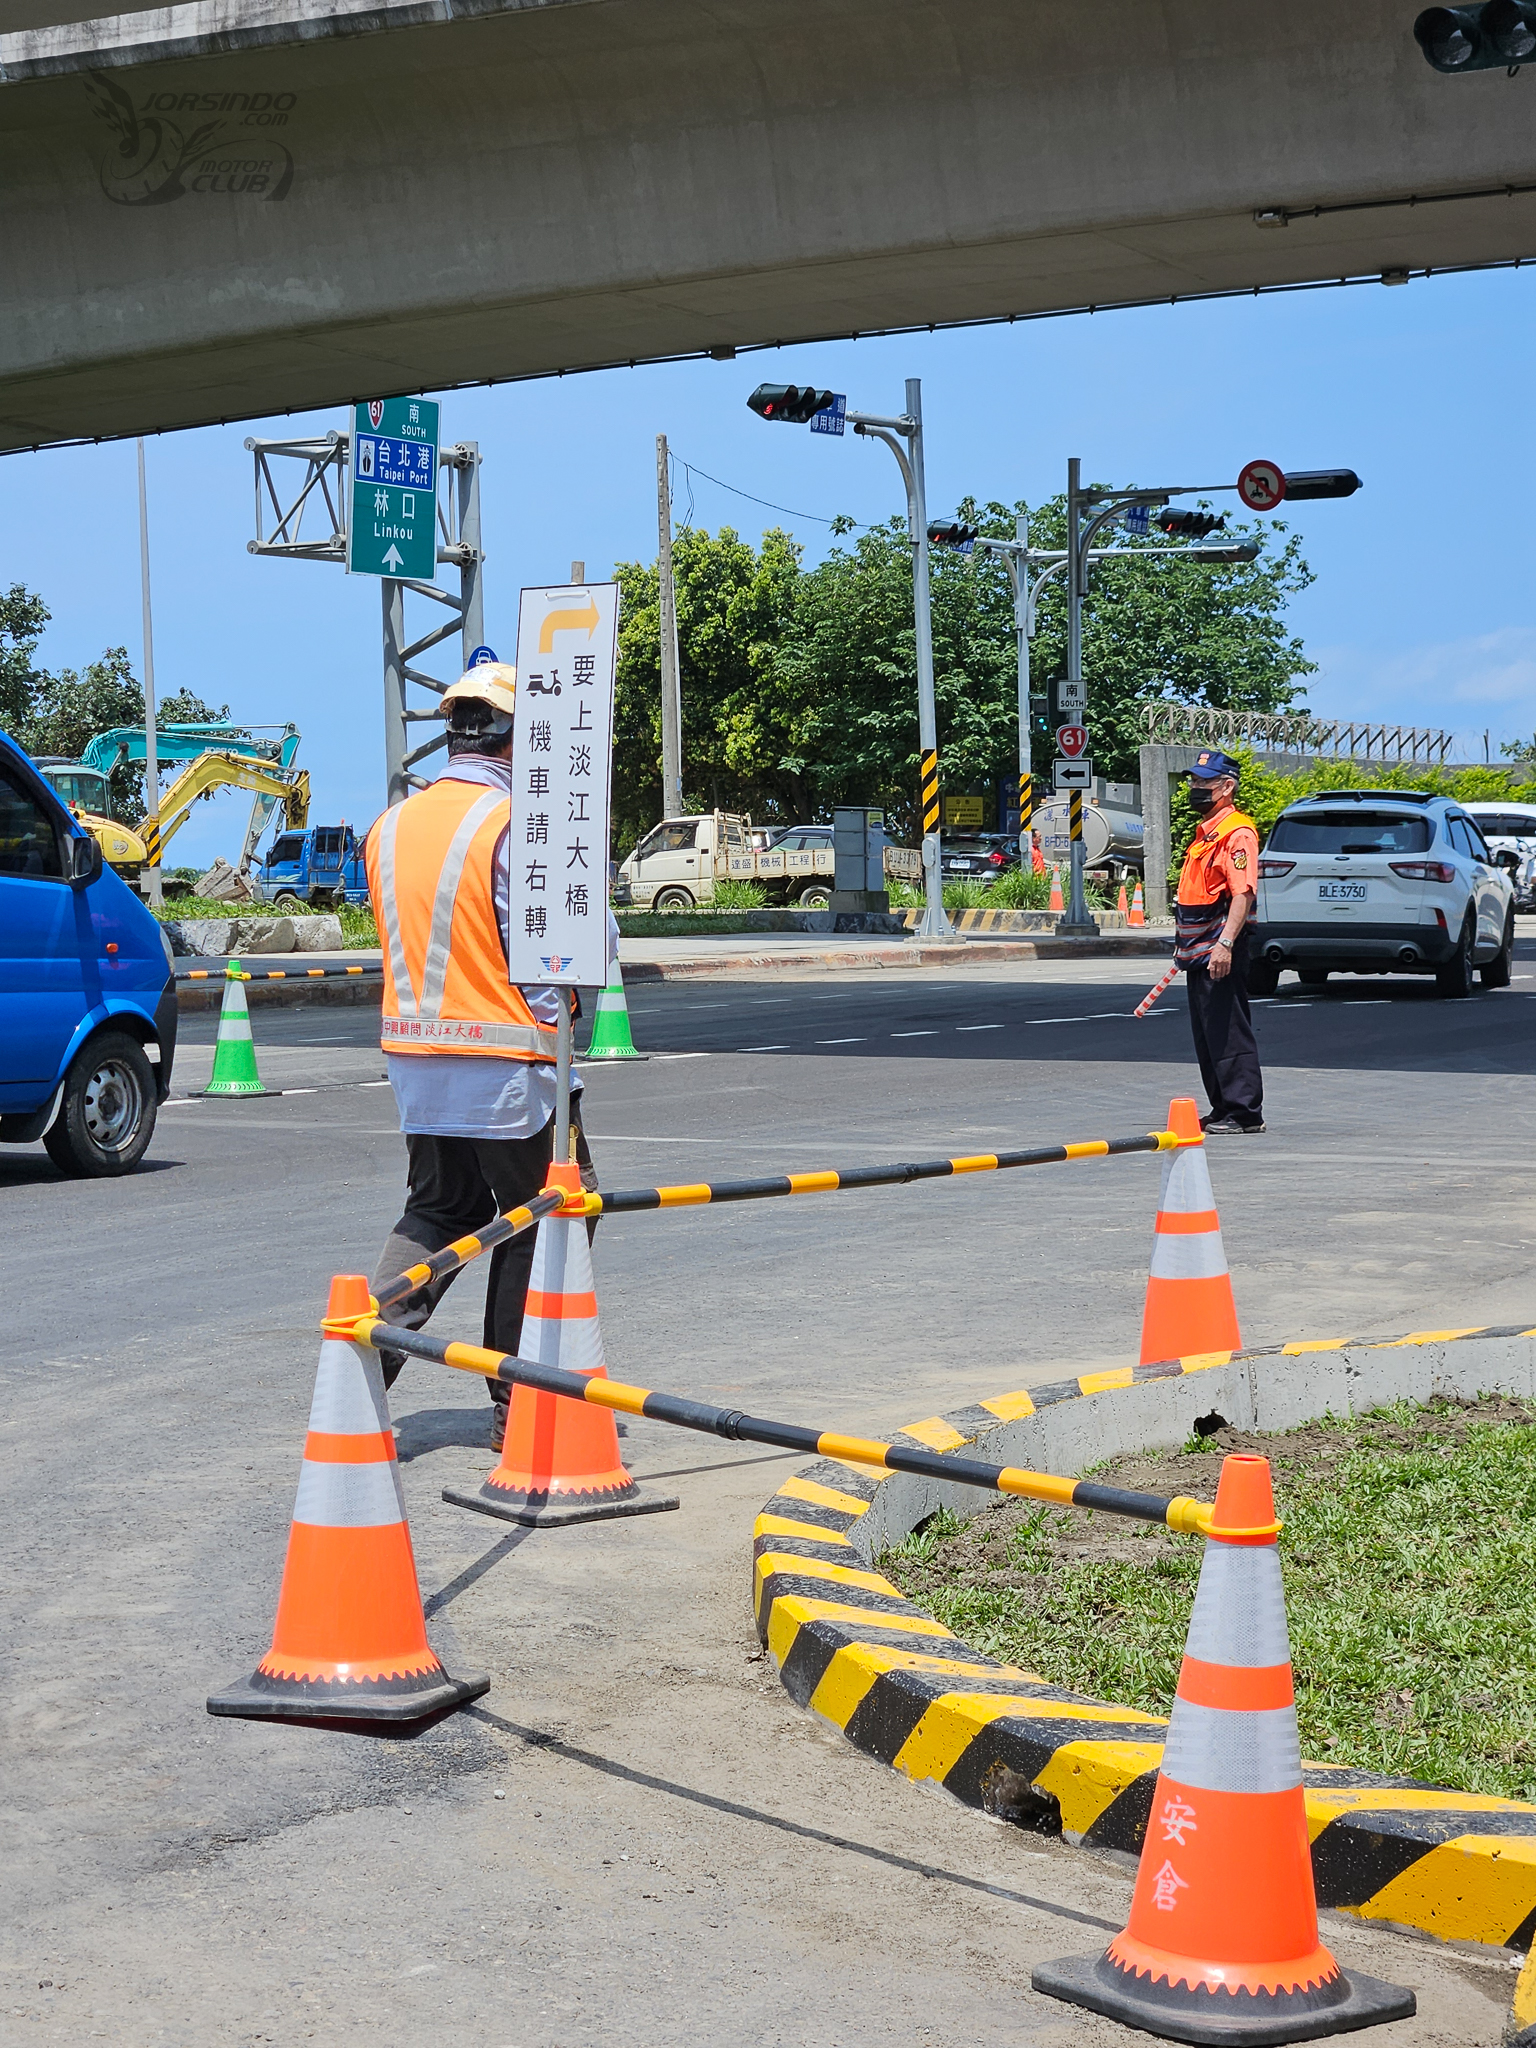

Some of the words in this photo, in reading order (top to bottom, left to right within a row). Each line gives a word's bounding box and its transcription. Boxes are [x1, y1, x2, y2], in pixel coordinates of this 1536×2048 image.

[371, 400, 381, 418] 61
[409, 404, 419, 423] 南
[401, 424, 427, 438] SOUTH
[378, 440, 430, 470] 台北港
[379, 466, 405, 482] Taipei
[409, 472, 428, 485] Port
[374, 488, 415, 520] 林口
[374, 522, 413, 540] Linkou
[1066, 684, 1078, 697] 南
[1060, 700, 1084, 708] SOUTH
[1062, 730, 1082, 746] 61
[565, 655, 596, 917] 要上淡江大橋
[525, 720, 552, 939] 機車請右轉
[1319, 885, 1366, 898] BLE-3730
[425, 1023, 483, 1040] 淡江大橋
[1151, 1794, 1198, 1912] 安倉
